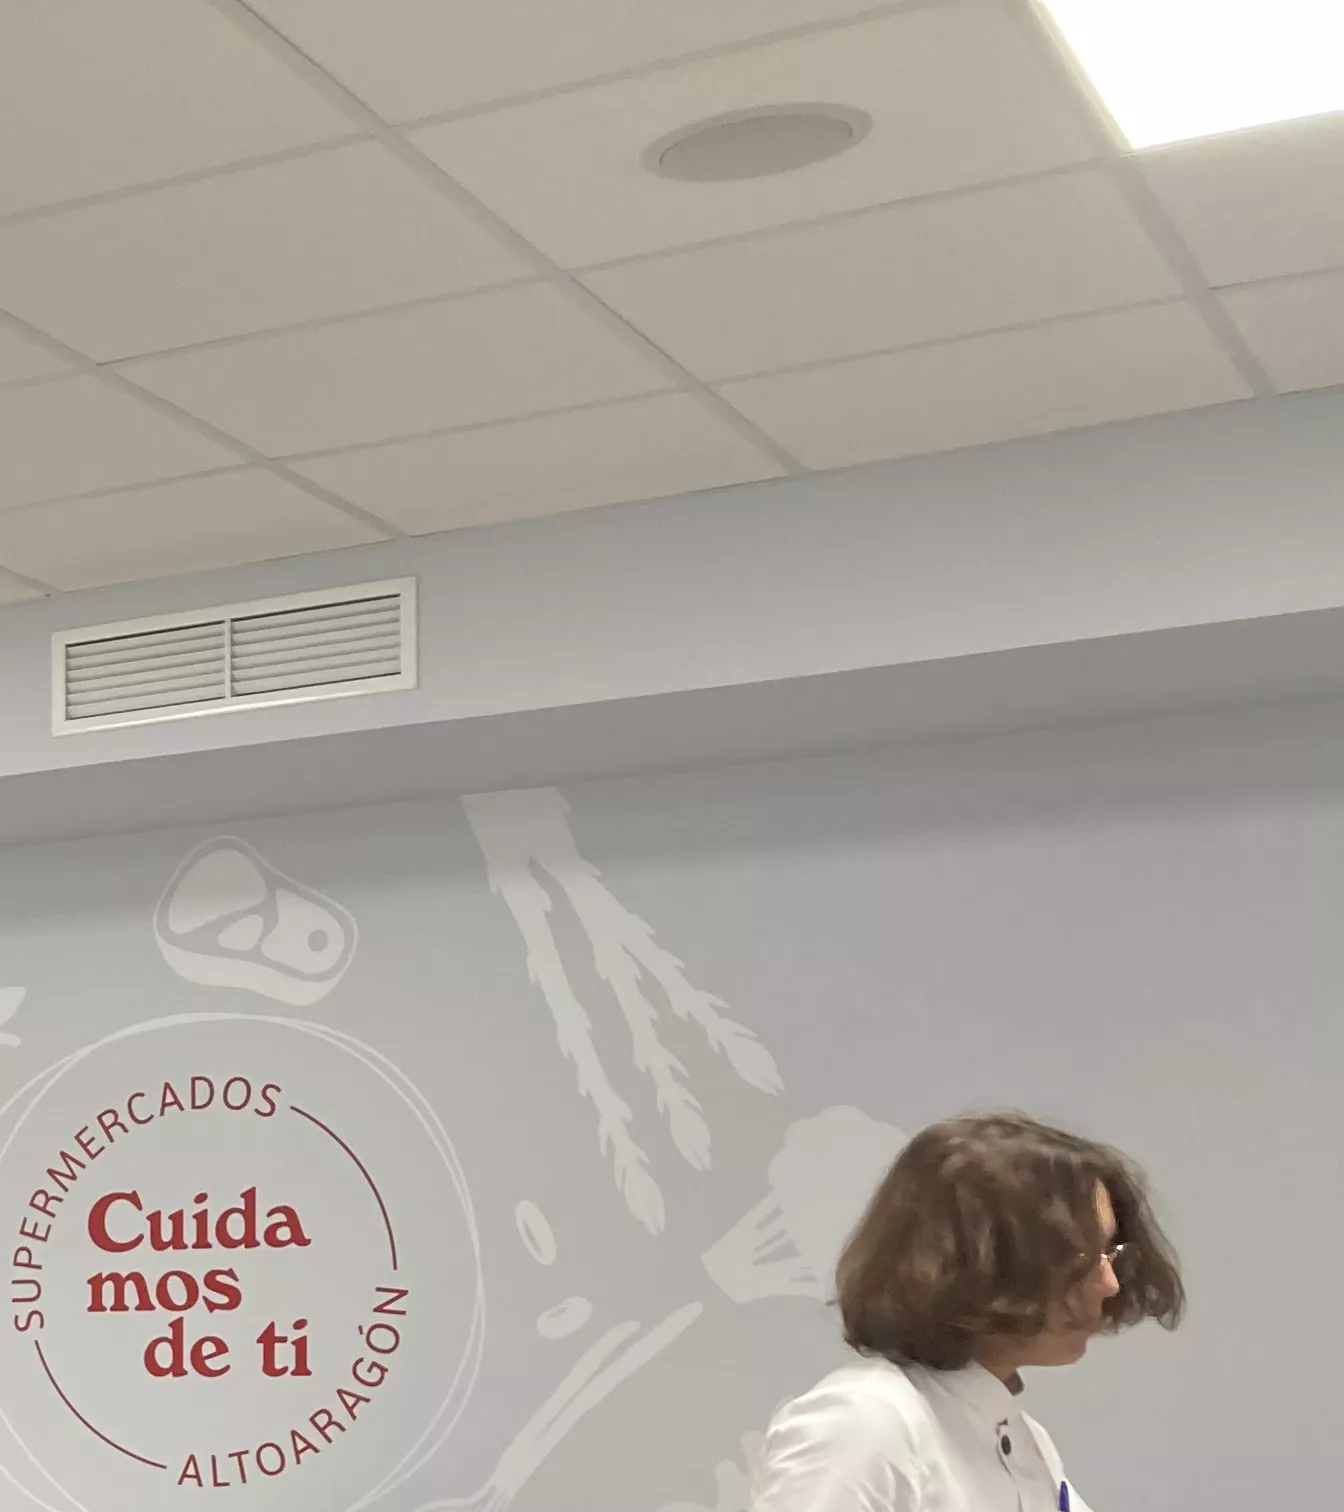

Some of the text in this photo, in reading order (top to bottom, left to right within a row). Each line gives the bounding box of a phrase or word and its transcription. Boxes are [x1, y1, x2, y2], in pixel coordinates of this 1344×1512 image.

[10, 1076, 282, 1333] SUPERMERCADOS
[86, 1186, 312, 1254] Cuida
[86, 1268, 244, 1314] mos
[143, 1316, 313, 1378] de ti
[177, 1286, 410, 1488] ALTOARAGÓN
